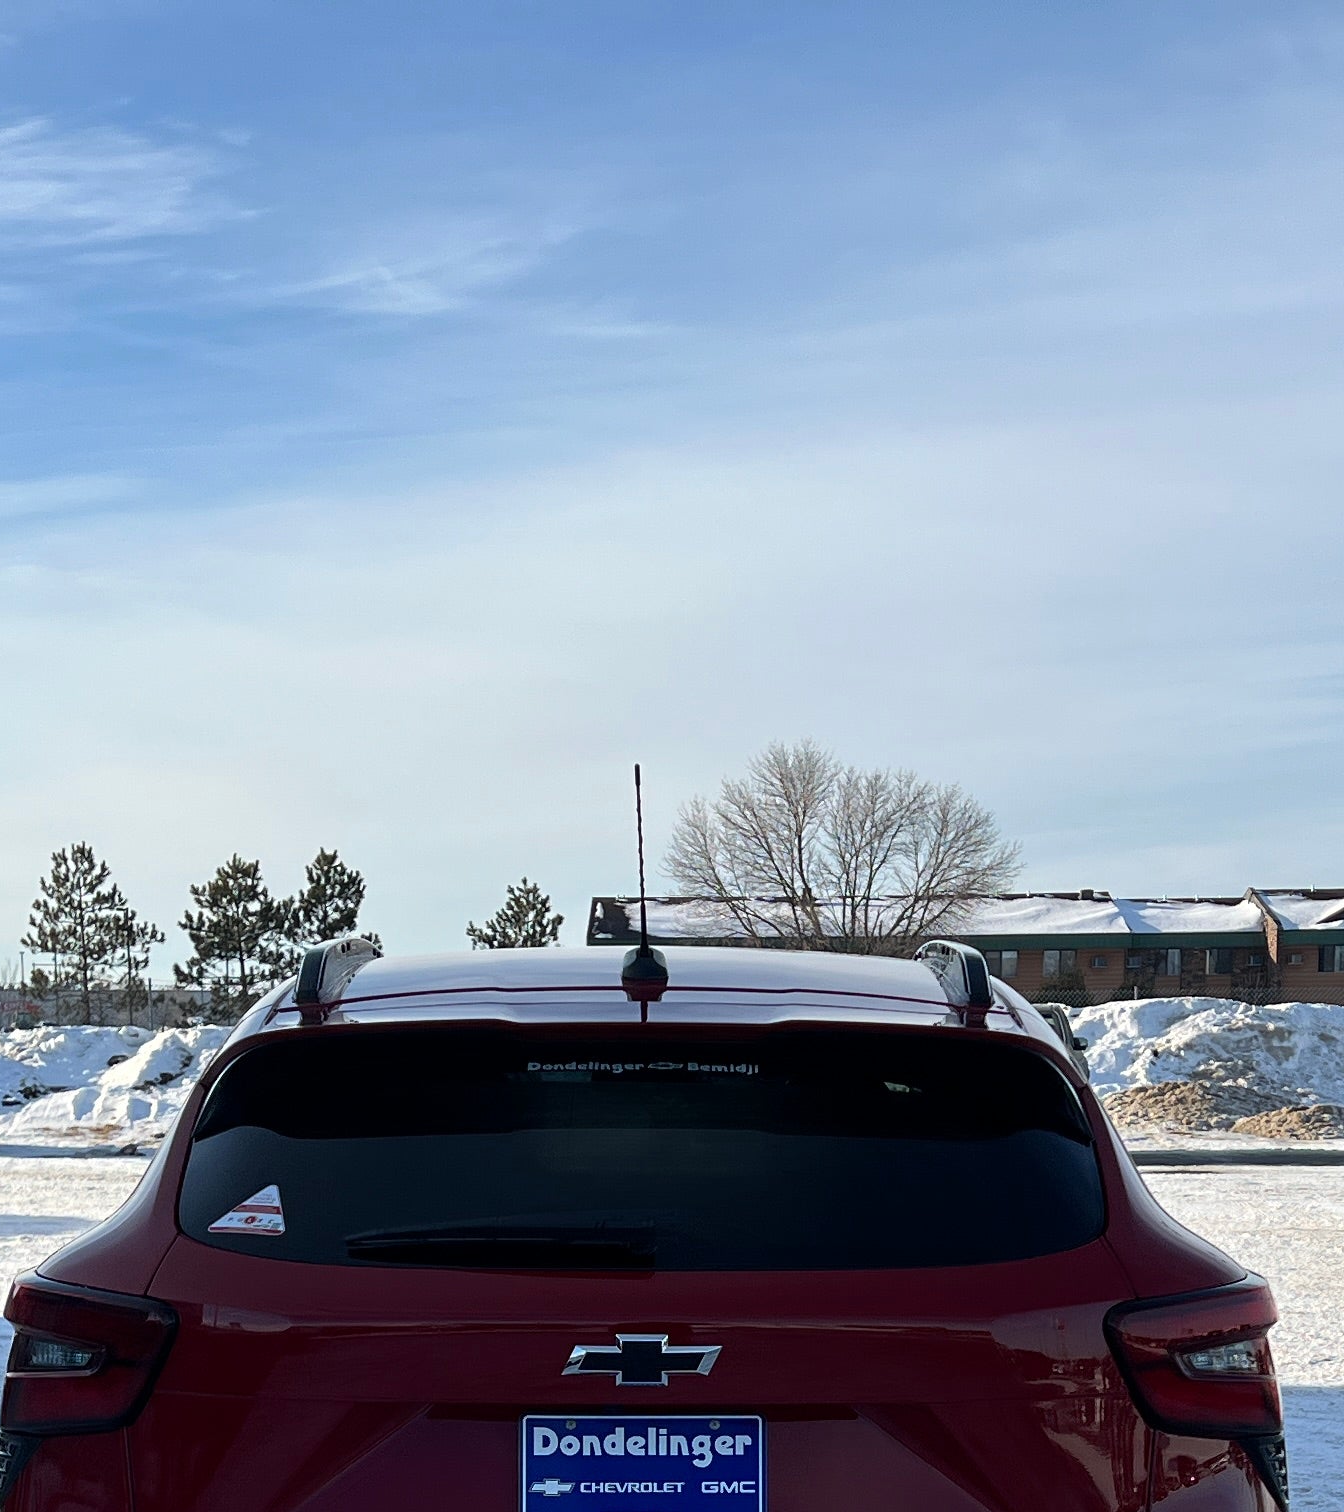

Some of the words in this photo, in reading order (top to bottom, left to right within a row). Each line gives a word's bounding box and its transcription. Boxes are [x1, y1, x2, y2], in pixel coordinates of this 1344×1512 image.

[527, 1061, 644, 1074] Dondelinger
[687, 1062, 759, 1075] Bemidji
[533, 1427, 752, 1468] Dondelinger
[579, 1482, 685, 1493] CHEVROLET
[701, 1481, 756, 1494] GMC
